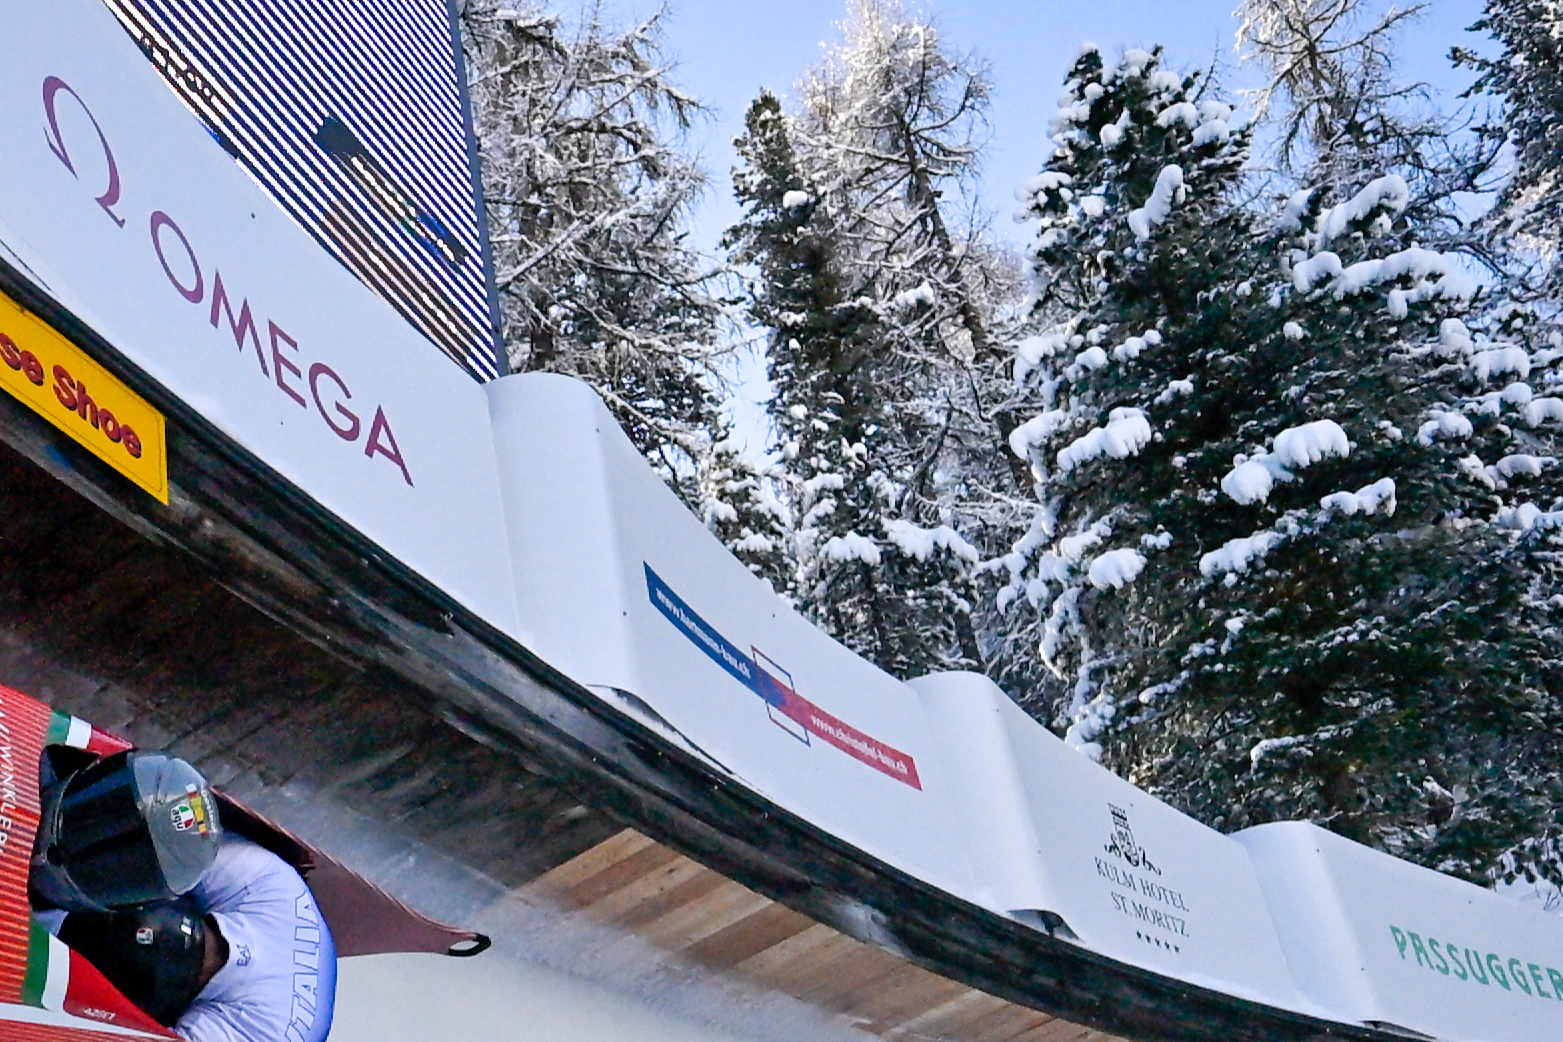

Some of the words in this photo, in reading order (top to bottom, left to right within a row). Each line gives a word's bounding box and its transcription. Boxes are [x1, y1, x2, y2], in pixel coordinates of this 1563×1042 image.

[150, 210, 415, 487] OMEGA
[52, 363, 143, 460] Shoe
[1094, 855, 1138, 892] KULM
[1139, 877, 1190, 913] HOTEL
